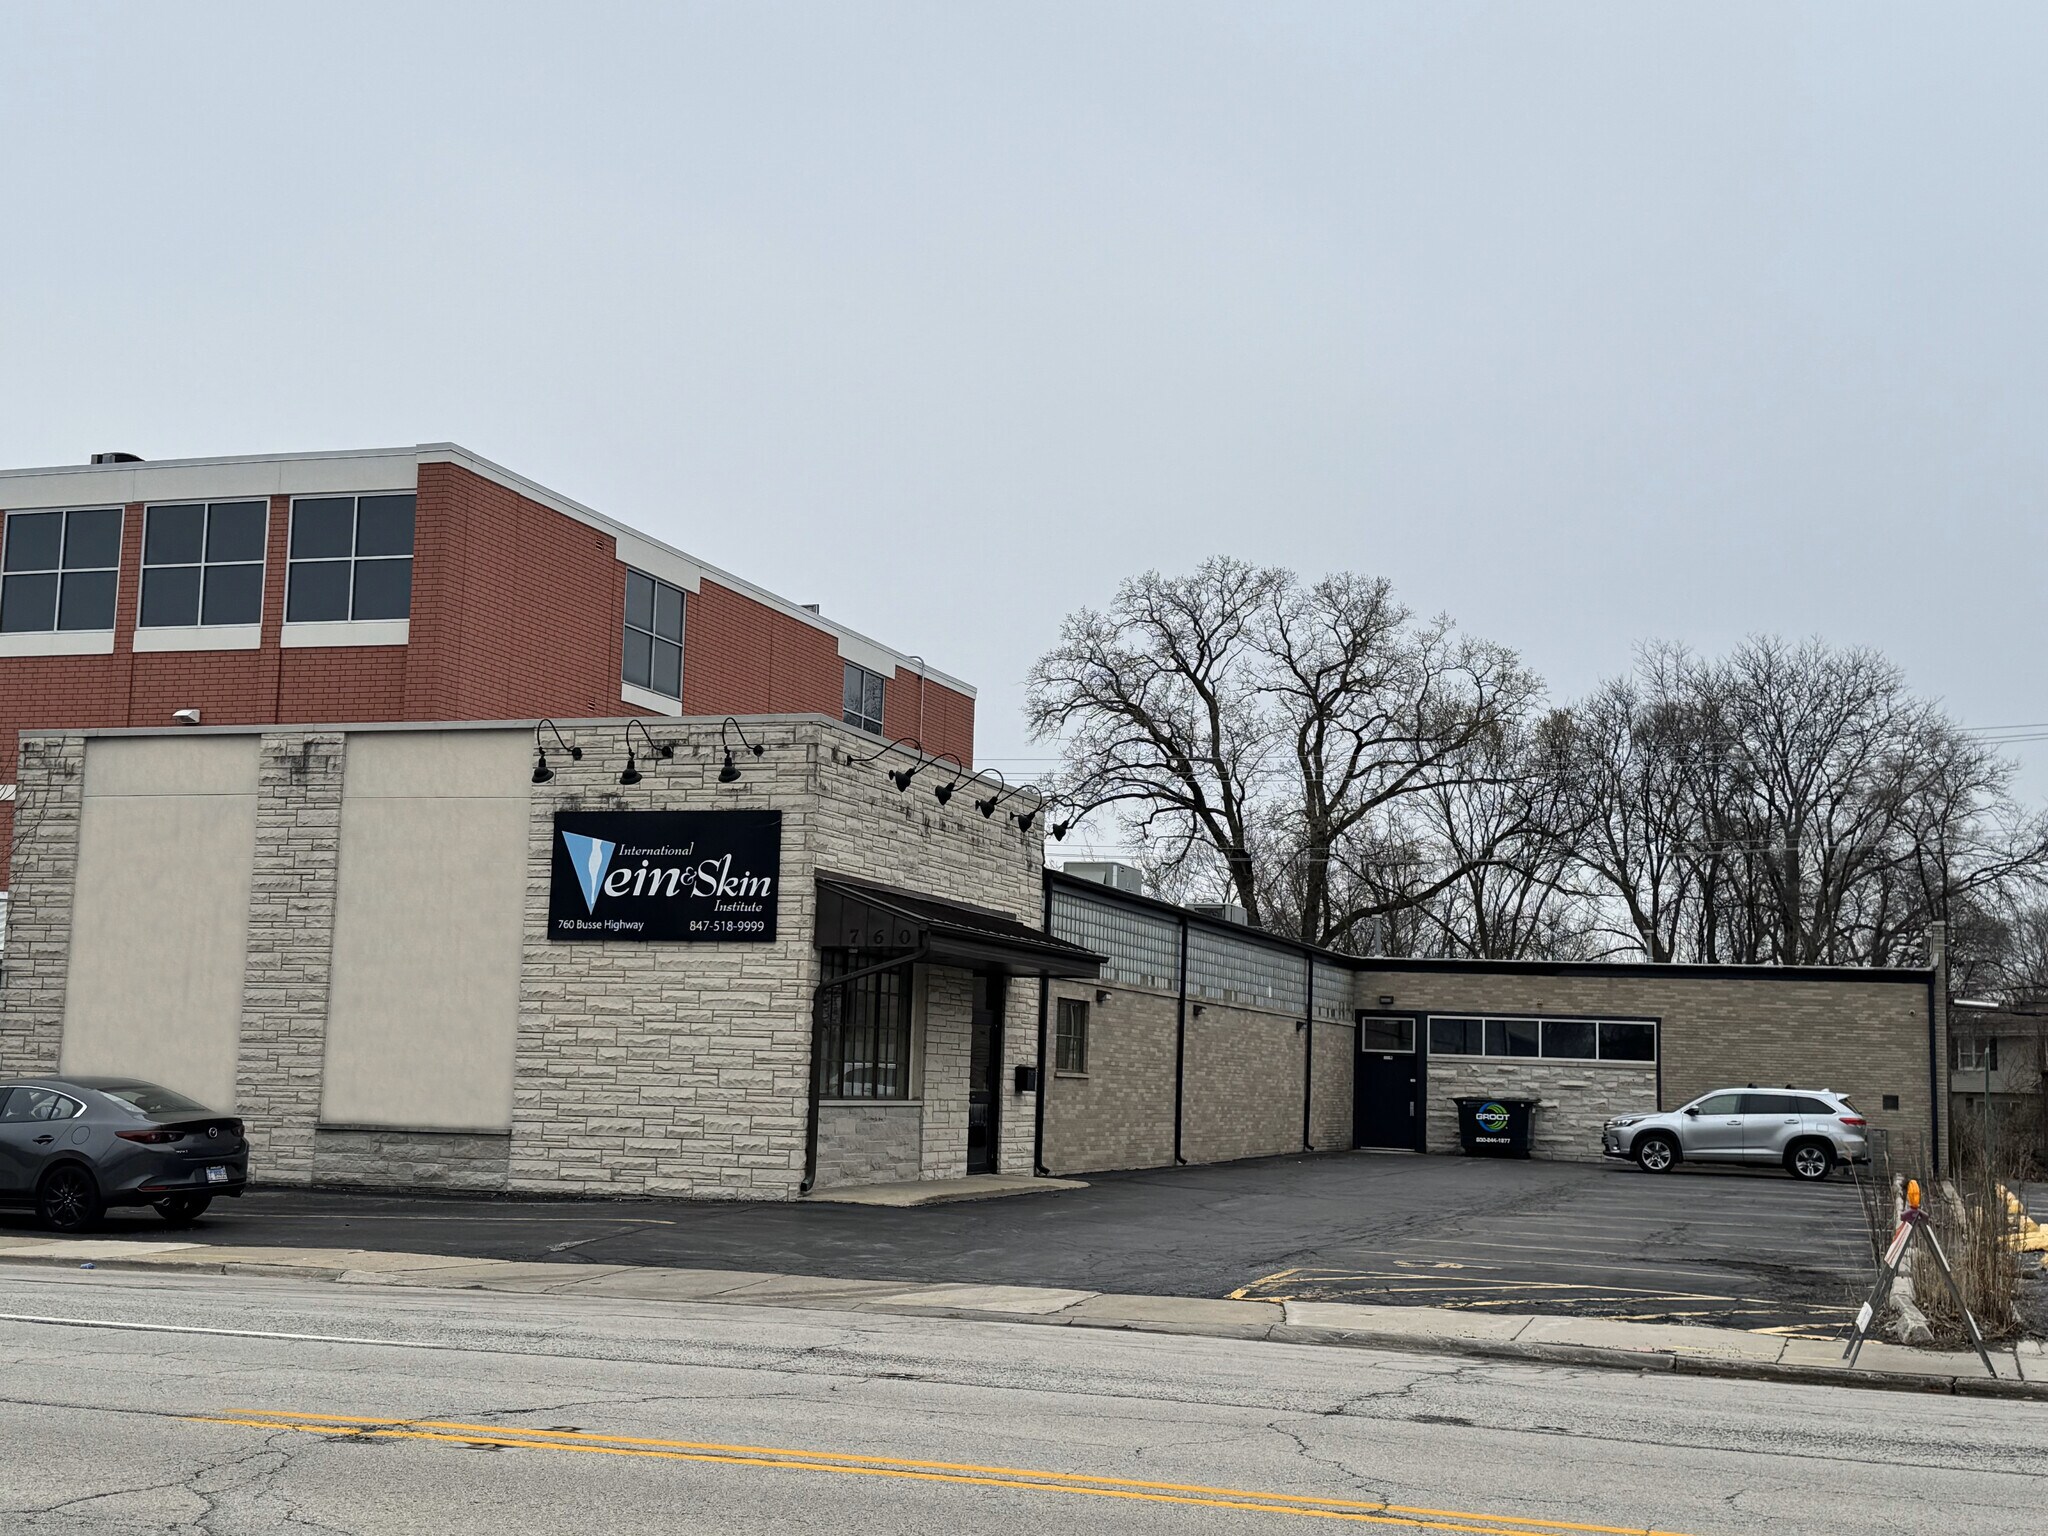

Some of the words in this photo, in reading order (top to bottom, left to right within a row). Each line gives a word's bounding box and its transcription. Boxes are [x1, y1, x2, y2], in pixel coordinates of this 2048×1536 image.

[618, 841, 695, 856] International
[690, 853, 772, 898] Skin
[714, 899, 763, 912] Institute
[558, 919, 575, 929] 760
[576, 919, 602, 930] Busse
[604, 919, 645, 932] Highway
[689, 920, 765, 932] 847-518-9999
[849, 929, 911, 945] 760
[1475, 1113, 1511, 1121] GROOT
